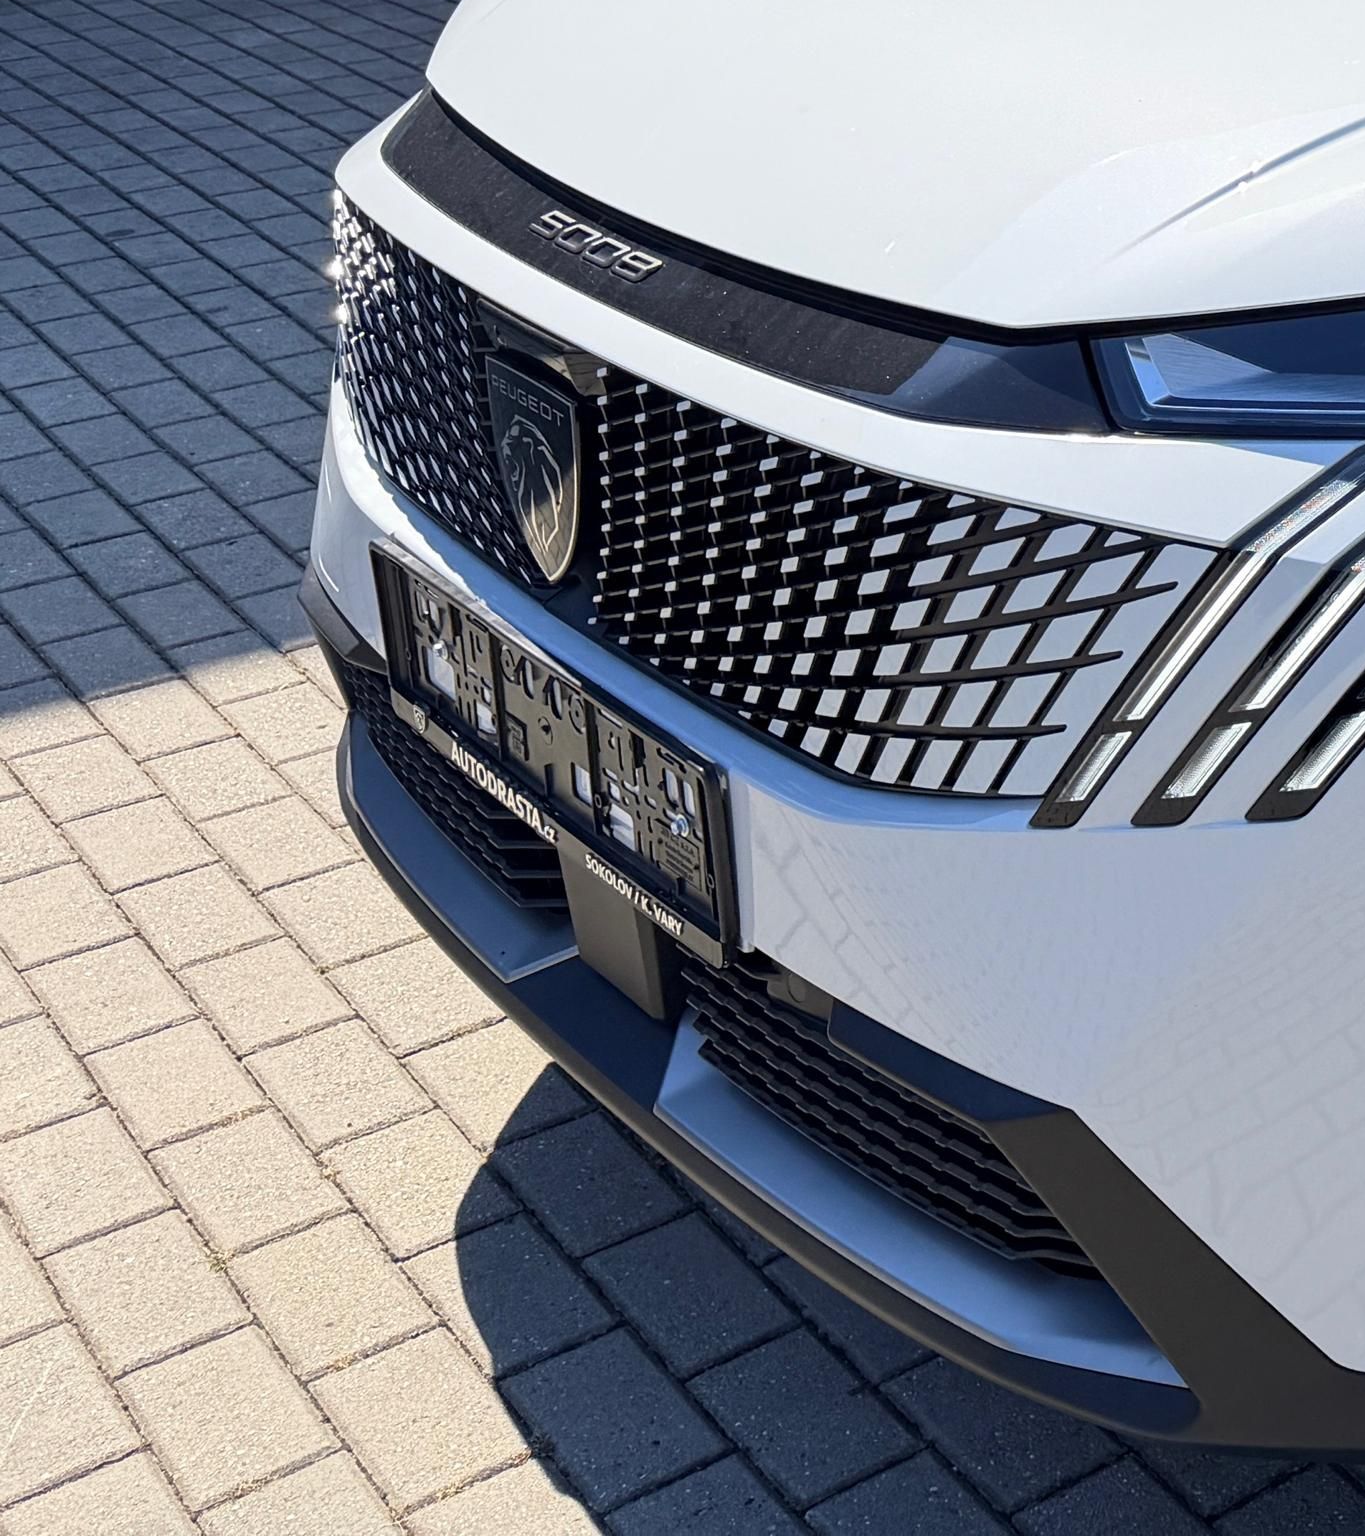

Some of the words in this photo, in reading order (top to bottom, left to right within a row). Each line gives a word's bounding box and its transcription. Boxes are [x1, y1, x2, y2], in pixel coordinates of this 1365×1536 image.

[528, 210, 663, 284] 5008
[491, 374, 565, 427] PEUGEOT
[585, 853, 634, 900] SOKOLOV
[640, 893, 653, 915] K.
[653, 903, 684, 936] VARY
